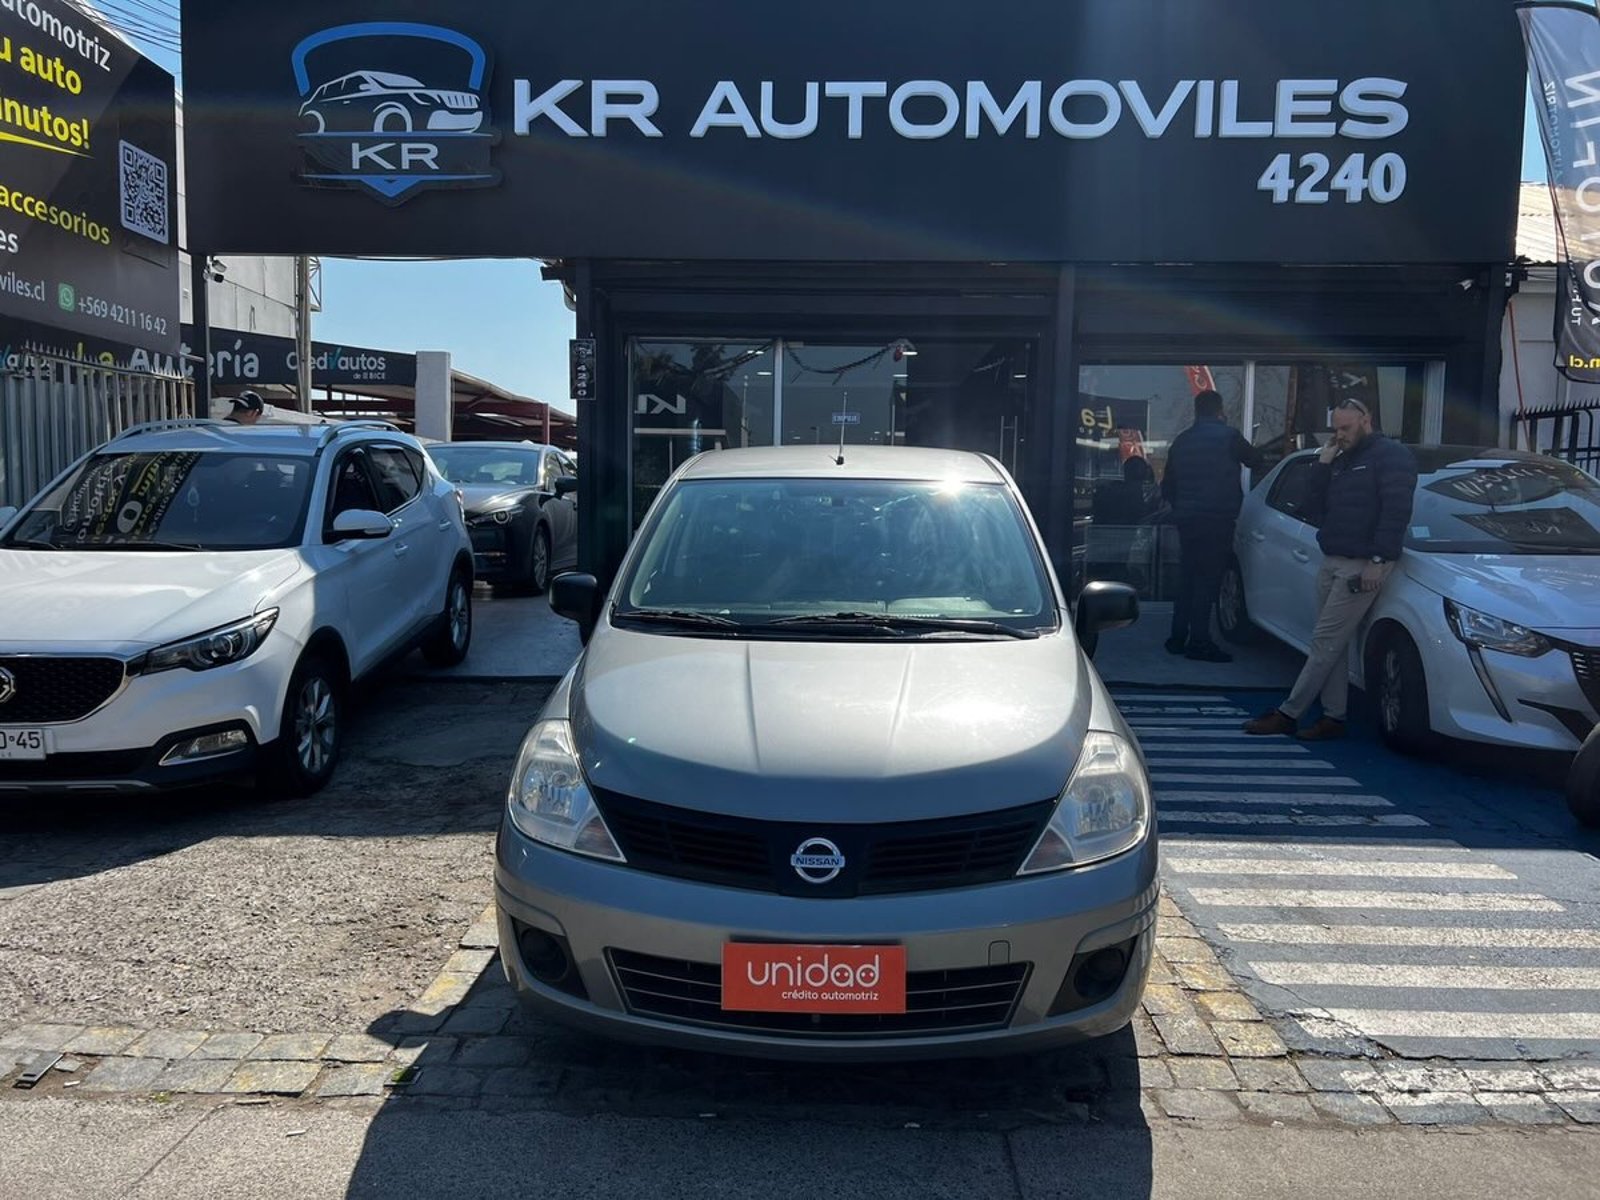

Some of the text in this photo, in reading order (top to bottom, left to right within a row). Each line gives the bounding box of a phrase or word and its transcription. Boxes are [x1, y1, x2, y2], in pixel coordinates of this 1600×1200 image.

[20, 47, 82, 95] auto
[0, 98, 90, 149] nutos!
[514, 77, 1409, 140] KR AUTOMOVILES
[351, 143, 440, 169] KR
[1257, 152, 1408, 204] 4240
[78, 297, 108, 318] +569
[111, 304, 136, 327] 4211
[795, 856, 840, 866] NISSAN
[747, 953, 880, 988] unidad
[782, 989, 879, 1001] crédito automotriz
